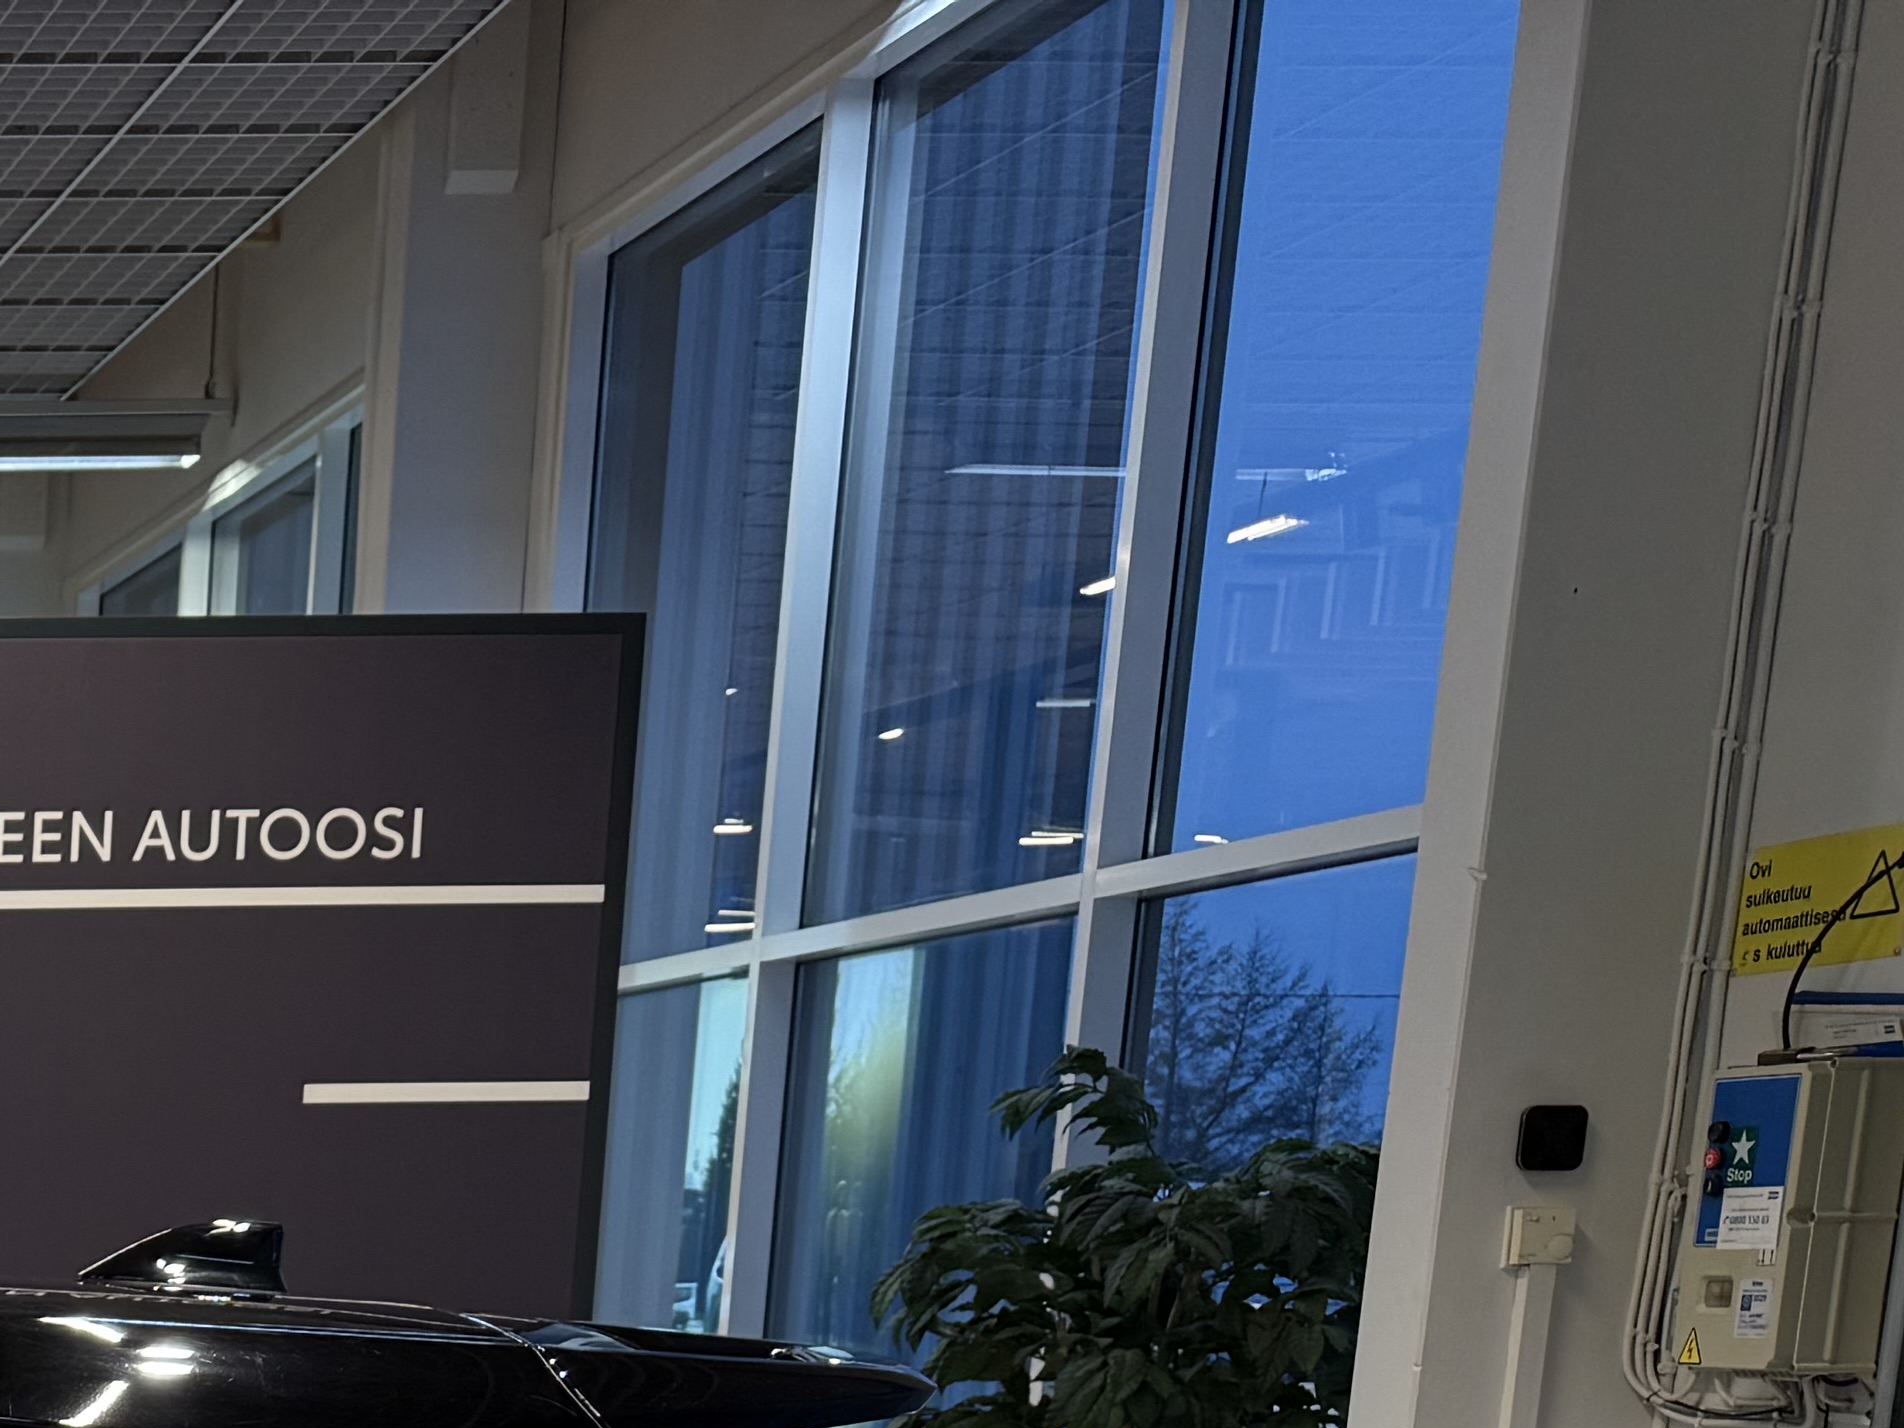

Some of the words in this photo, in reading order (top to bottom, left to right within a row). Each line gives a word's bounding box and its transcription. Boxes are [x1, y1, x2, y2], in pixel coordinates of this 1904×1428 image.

[132, 807, 424, 862] AUTOOSI
[1750, 859, 1773, 880] Ovi
[1726, 1167, 1753, 1184] Stop
